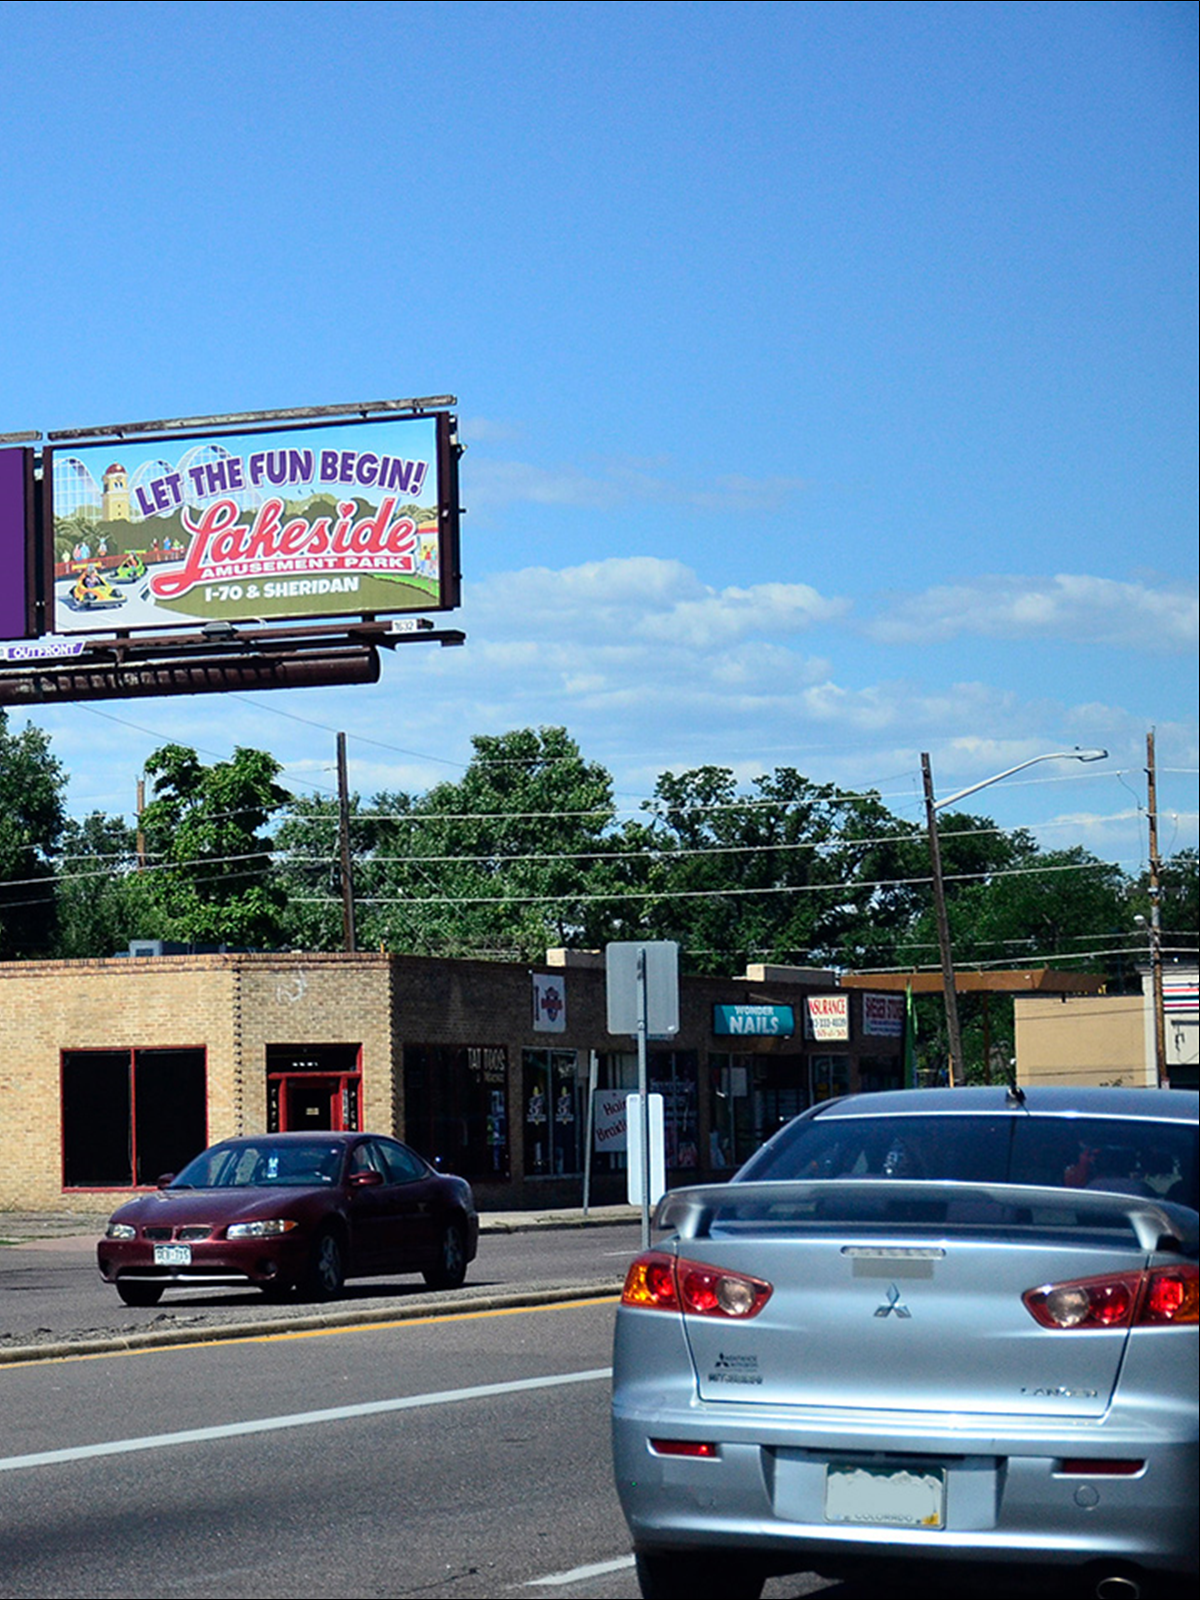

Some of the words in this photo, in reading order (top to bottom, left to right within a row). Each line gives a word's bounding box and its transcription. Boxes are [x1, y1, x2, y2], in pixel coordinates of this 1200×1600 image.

[135, 473, 183, 517] LET
[188, 458, 244, 497] THE
[250, 450, 313, 486] FUN
[320, 451, 426, 495] BEGIN!
[151, 498, 416, 596] Lakeside
[201, 557, 338, 579] AMUSEMENT
[344, 556, 406, 569] PARK
[205, 586, 243, 602] I-70
[246, 583, 260, 598] &
[265, 577, 360, 599] SHERIDAN
[13, 644, 76, 658] OUTFRONT
[735, 1005, 774, 1016] WONDER
[729, 1016, 780, 1034] NAILS
